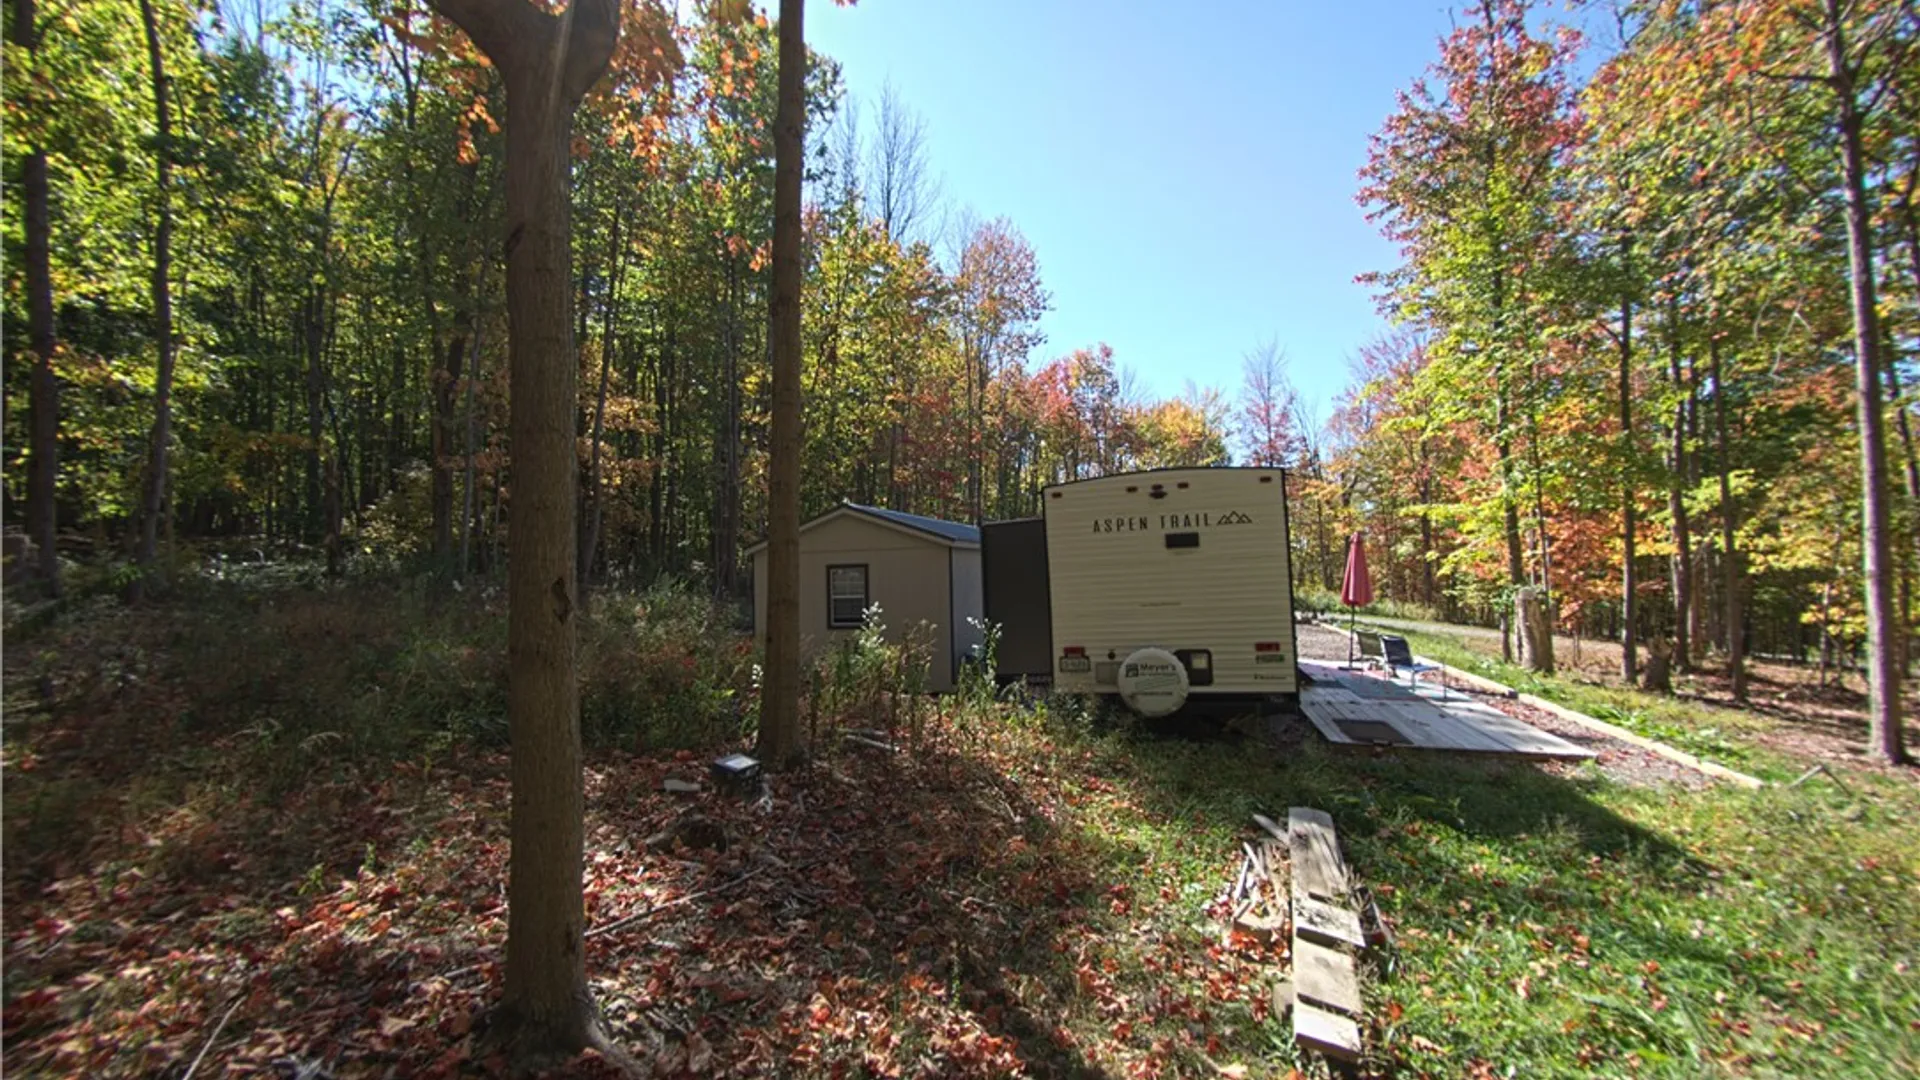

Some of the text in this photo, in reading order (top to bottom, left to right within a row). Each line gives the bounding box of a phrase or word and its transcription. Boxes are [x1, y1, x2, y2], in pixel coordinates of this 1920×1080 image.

[1093, 512, 1211, 533] ASPEN TRAIL
[1140, 662, 1177, 673] Meyer's
